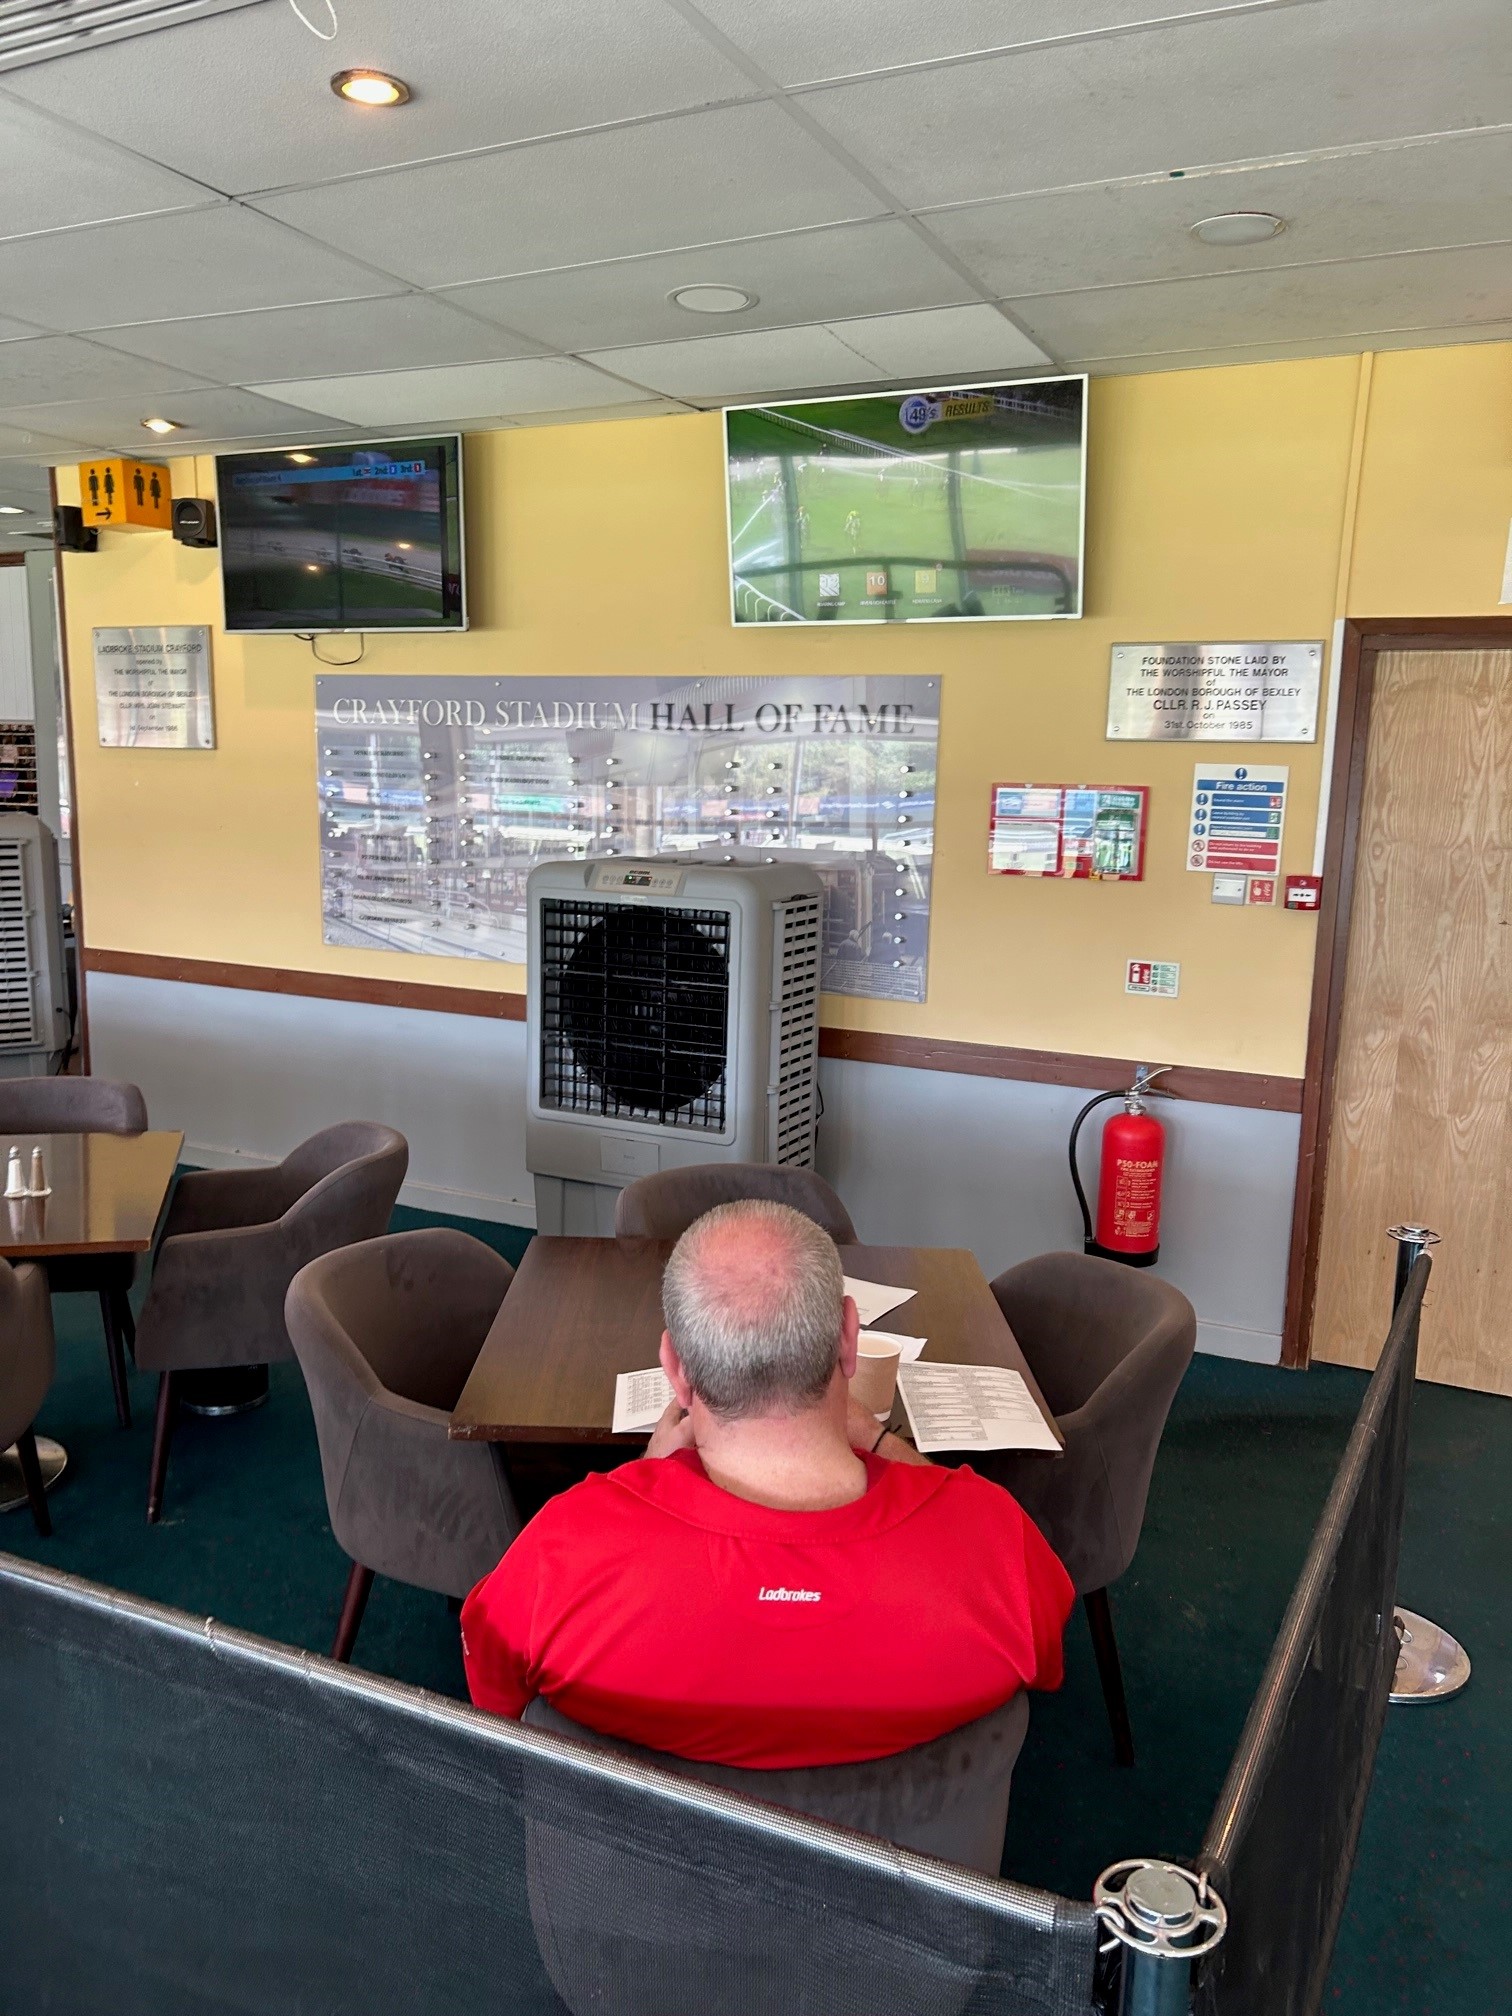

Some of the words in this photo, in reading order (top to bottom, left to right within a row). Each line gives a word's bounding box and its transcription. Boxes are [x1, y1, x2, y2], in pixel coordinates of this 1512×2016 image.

[945, 401, 989, 417] RESULTS
[869, 575, 885, 586] 10
[166, 643, 202, 653] CRAYFORD
[1141, 656, 1204, 666] FOUNDATION
[1207, 656, 1241, 665] STONE
[1244, 656, 1268, 665] LAID
[1272, 656, 1286, 665] BY
[1140, 668, 1159, 677] THE
[1162, 668, 1225, 678] WORSHIPFUL
[1229, 668, 1248, 677] THE
[1252, 668, 1288, 677] MAYOR
[1126, 688, 1144, 696] THE
[1147, 688, 1188, 697] LONDON
[1192, 688, 1241, 697] BOROUGH
[1244, 688, 1258, 697] OF
[1261, 688, 1301, 697] BEXLEY
[1216, 700, 1267, 711] PASSEY
[332, 697, 486, 728] CRAYFORD
[495, 700, 639, 731] STADIUM
[649, 702, 746, 733] HALL
[754, 702, 803, 734] OF
[812, 703, 915, 735] FAME
[1203, 712, 1214, 720] on
[1186, 720, 1225, 729] October
[1229, 721, 1253, 730] 1985
[1216, 781, 1234, 791] Fire
[1236, 783, 1268, 792] action
[758, 1586, 822, 1602] Ladbrokes
